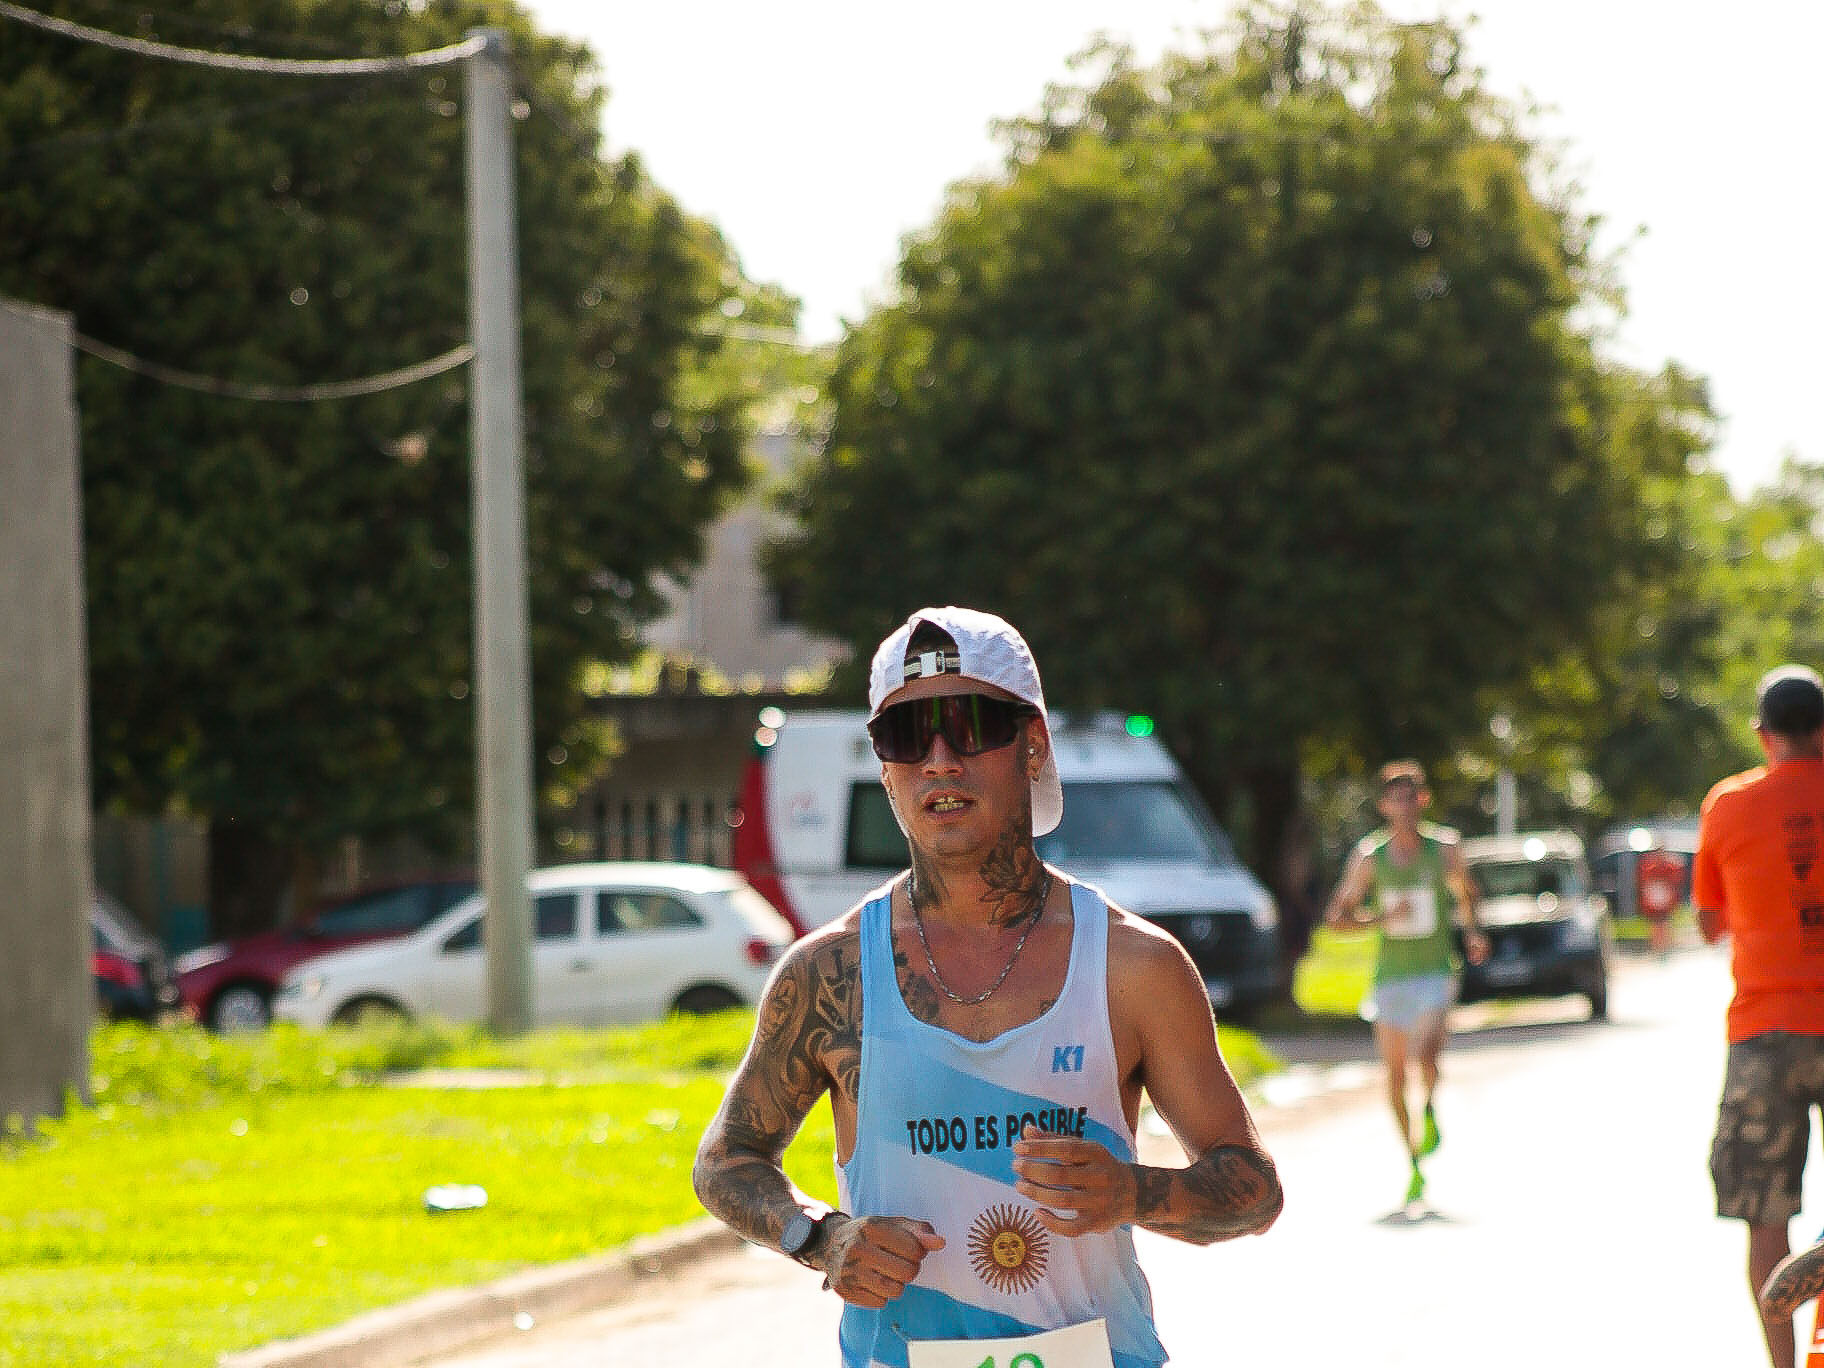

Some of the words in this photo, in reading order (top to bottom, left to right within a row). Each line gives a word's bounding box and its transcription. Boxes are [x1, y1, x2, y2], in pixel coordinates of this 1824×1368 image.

[1052, 1045, 1085, 1073] K1
[906, 1117, 967, 1155] TODO
[975, 1115, 999, 1150] ES
